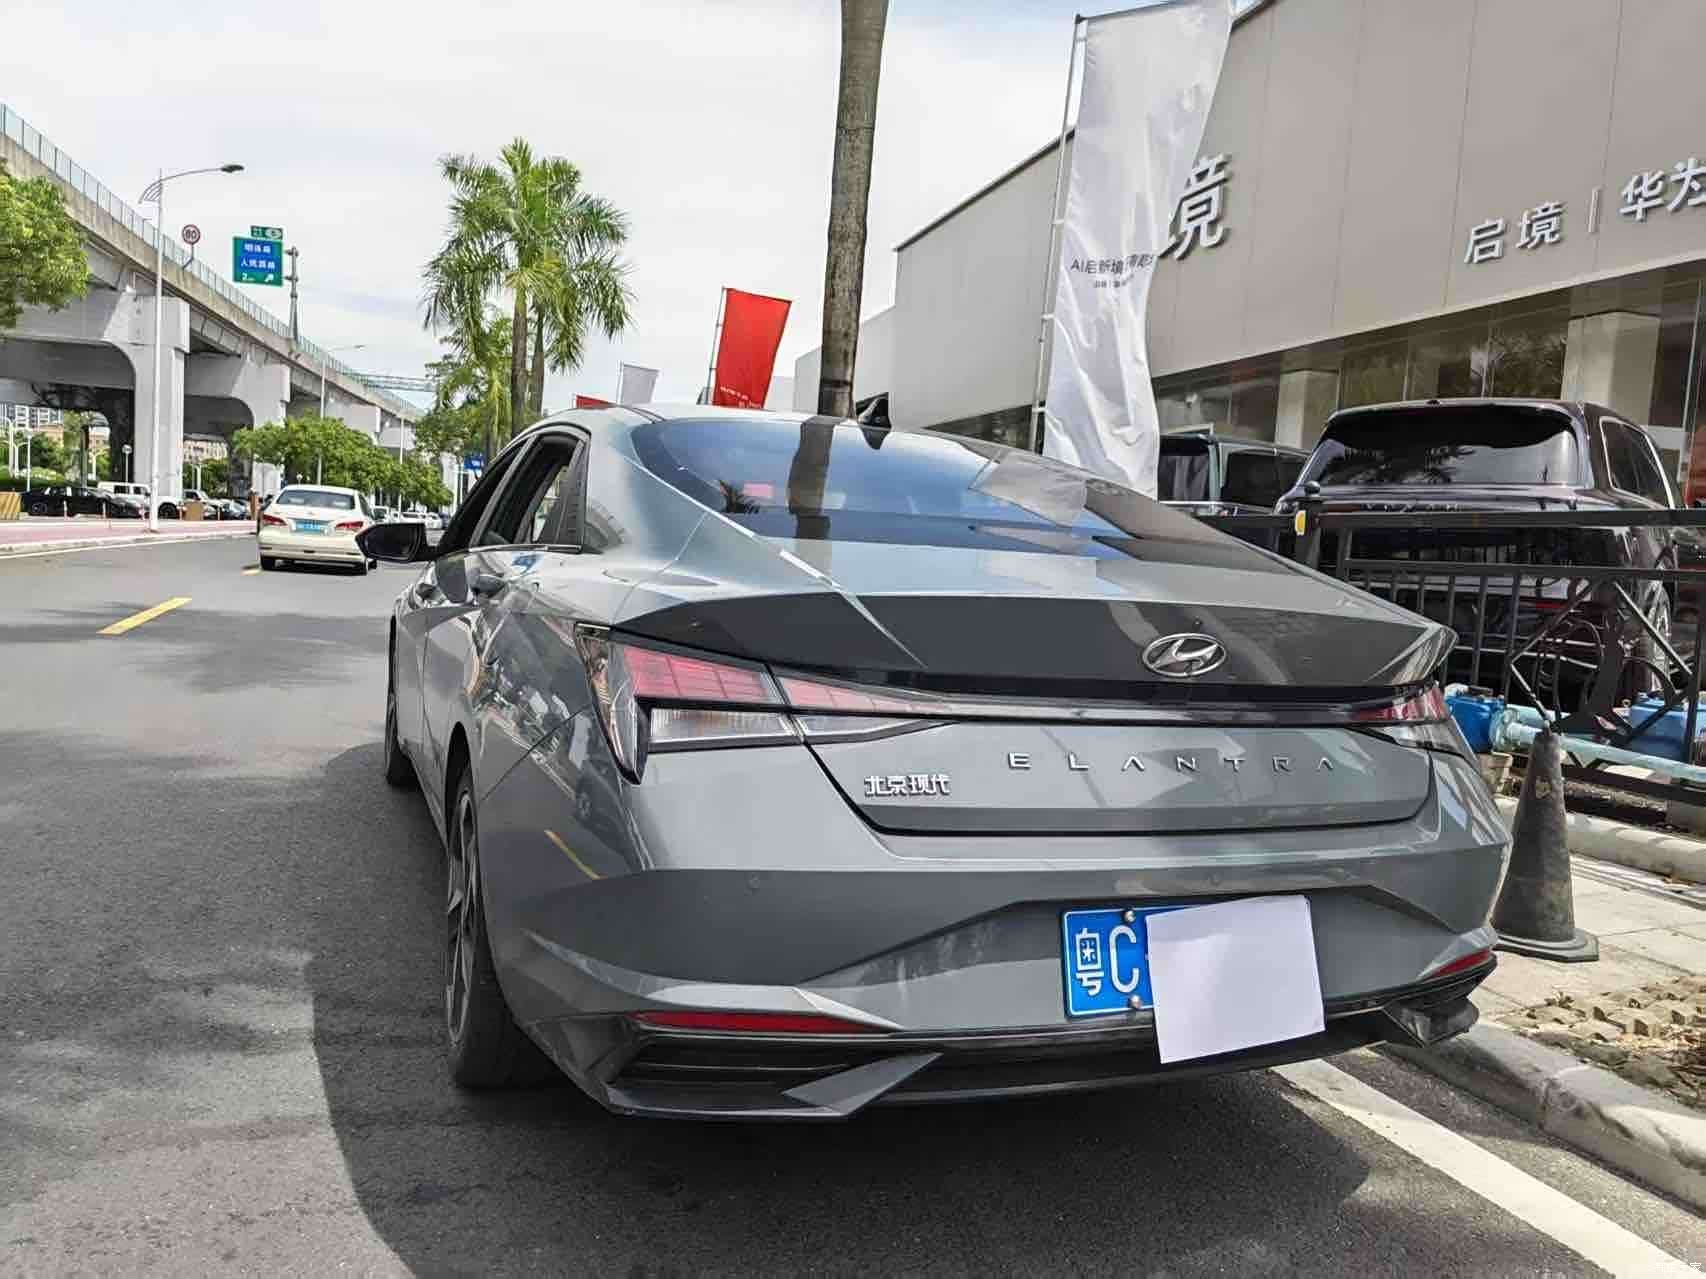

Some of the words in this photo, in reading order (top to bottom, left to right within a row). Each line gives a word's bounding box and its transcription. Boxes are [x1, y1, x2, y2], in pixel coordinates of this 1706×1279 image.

[1463, 201, 1564, 264] 启境
[1619, 158, 1706, 222] 华为
[1008, 752, 1334, 773] ELANTRA
[864, 774, 951, 797] 北京现代
